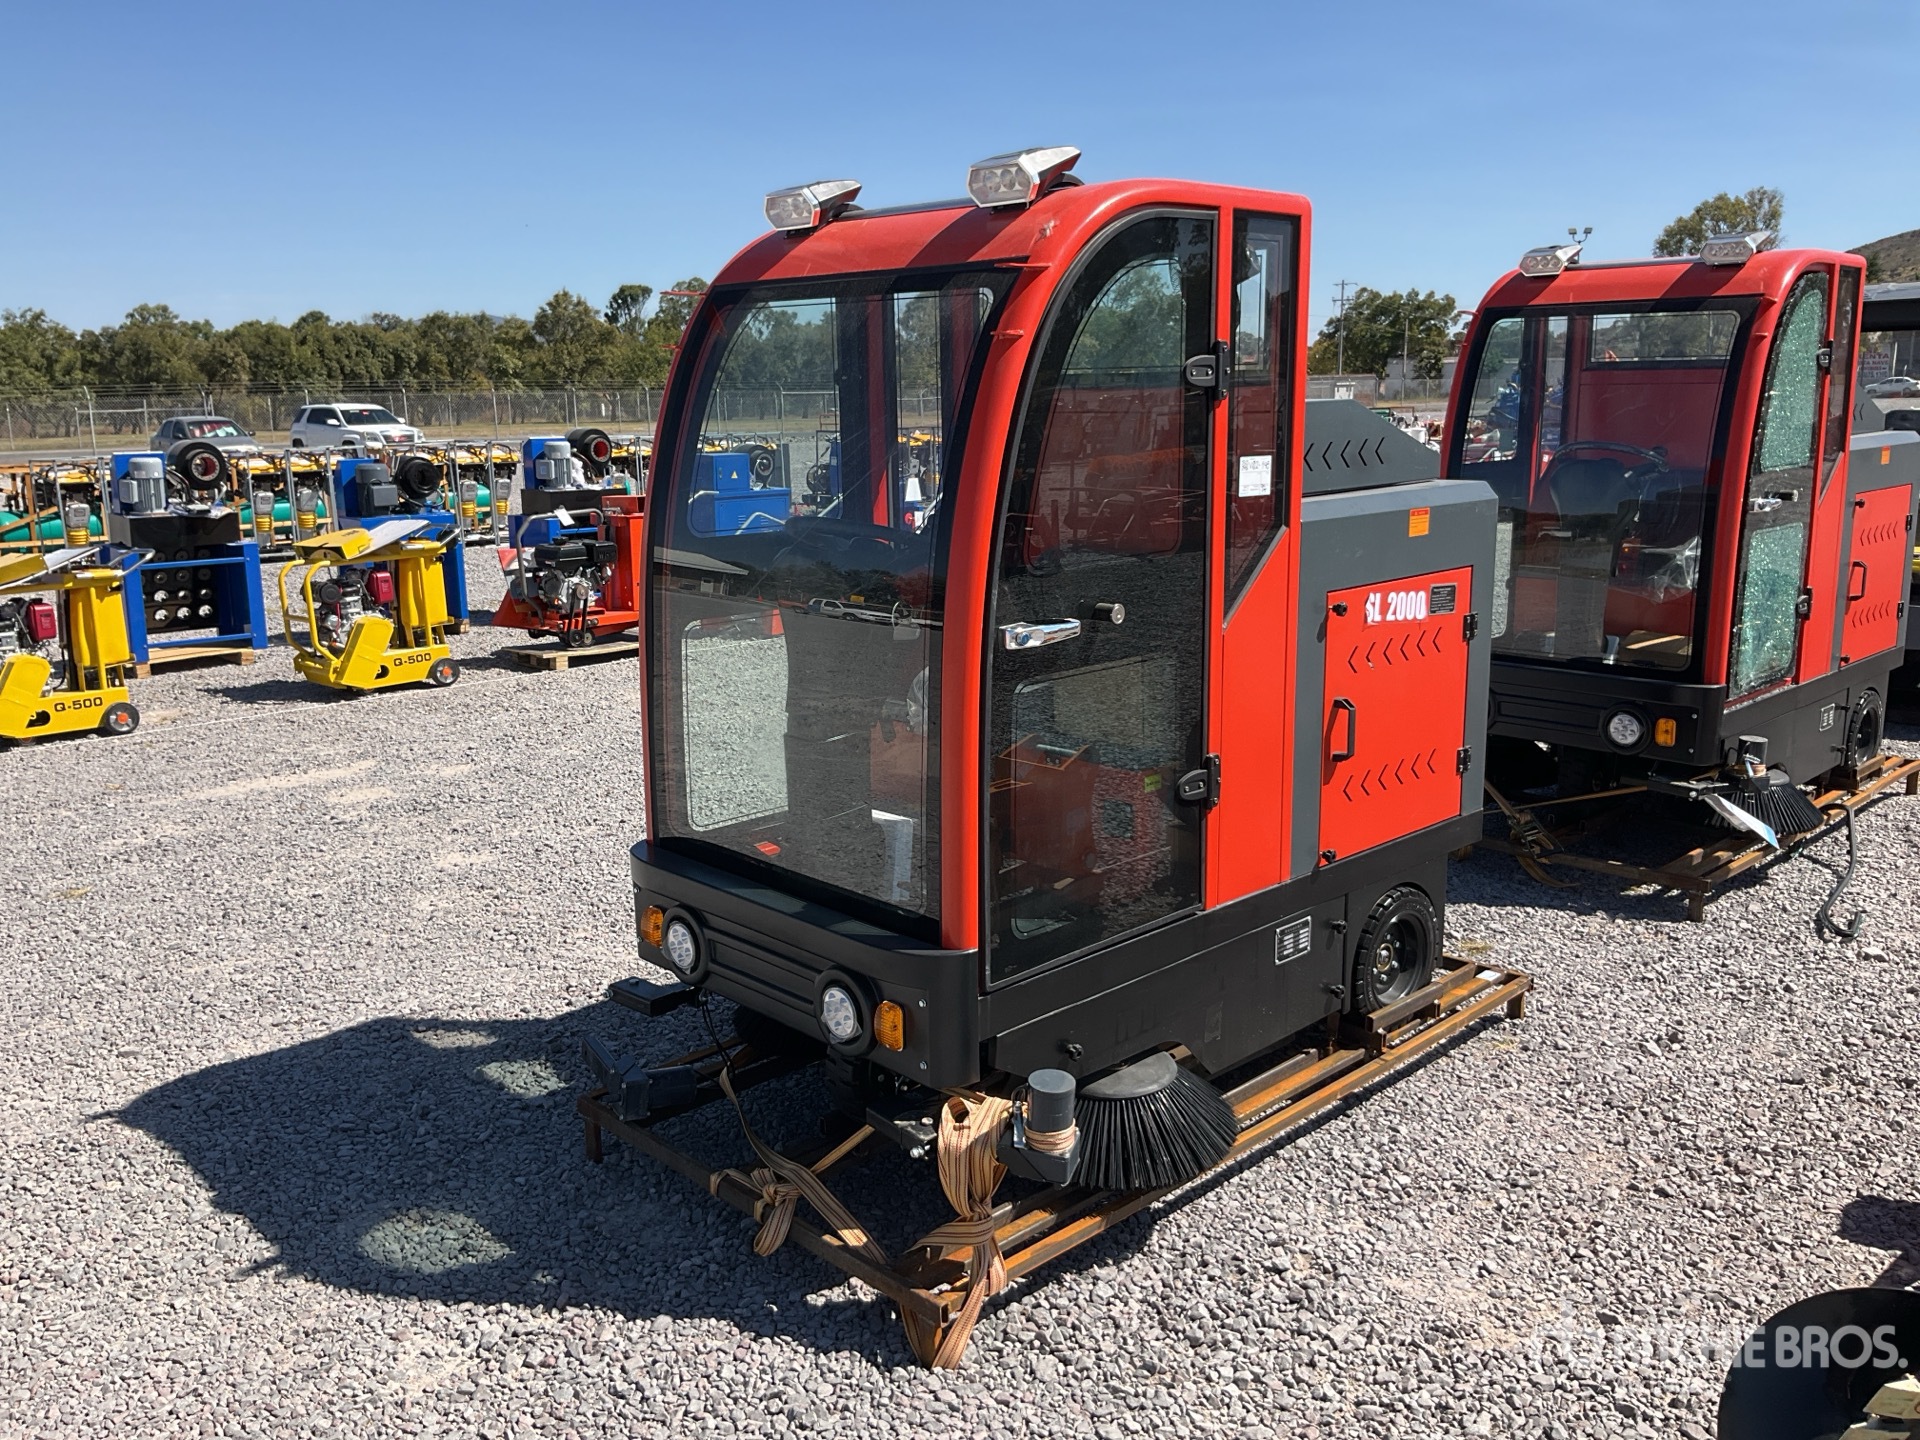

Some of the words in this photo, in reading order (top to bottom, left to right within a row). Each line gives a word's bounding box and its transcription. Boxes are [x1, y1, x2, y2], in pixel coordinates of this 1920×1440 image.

[1365, 592, 1382, 623] SL
[1386, 591, 1427, 621] 2000
[394, 653, 432, 667] Q-500
[54, 696, 103, 712] Q-500
